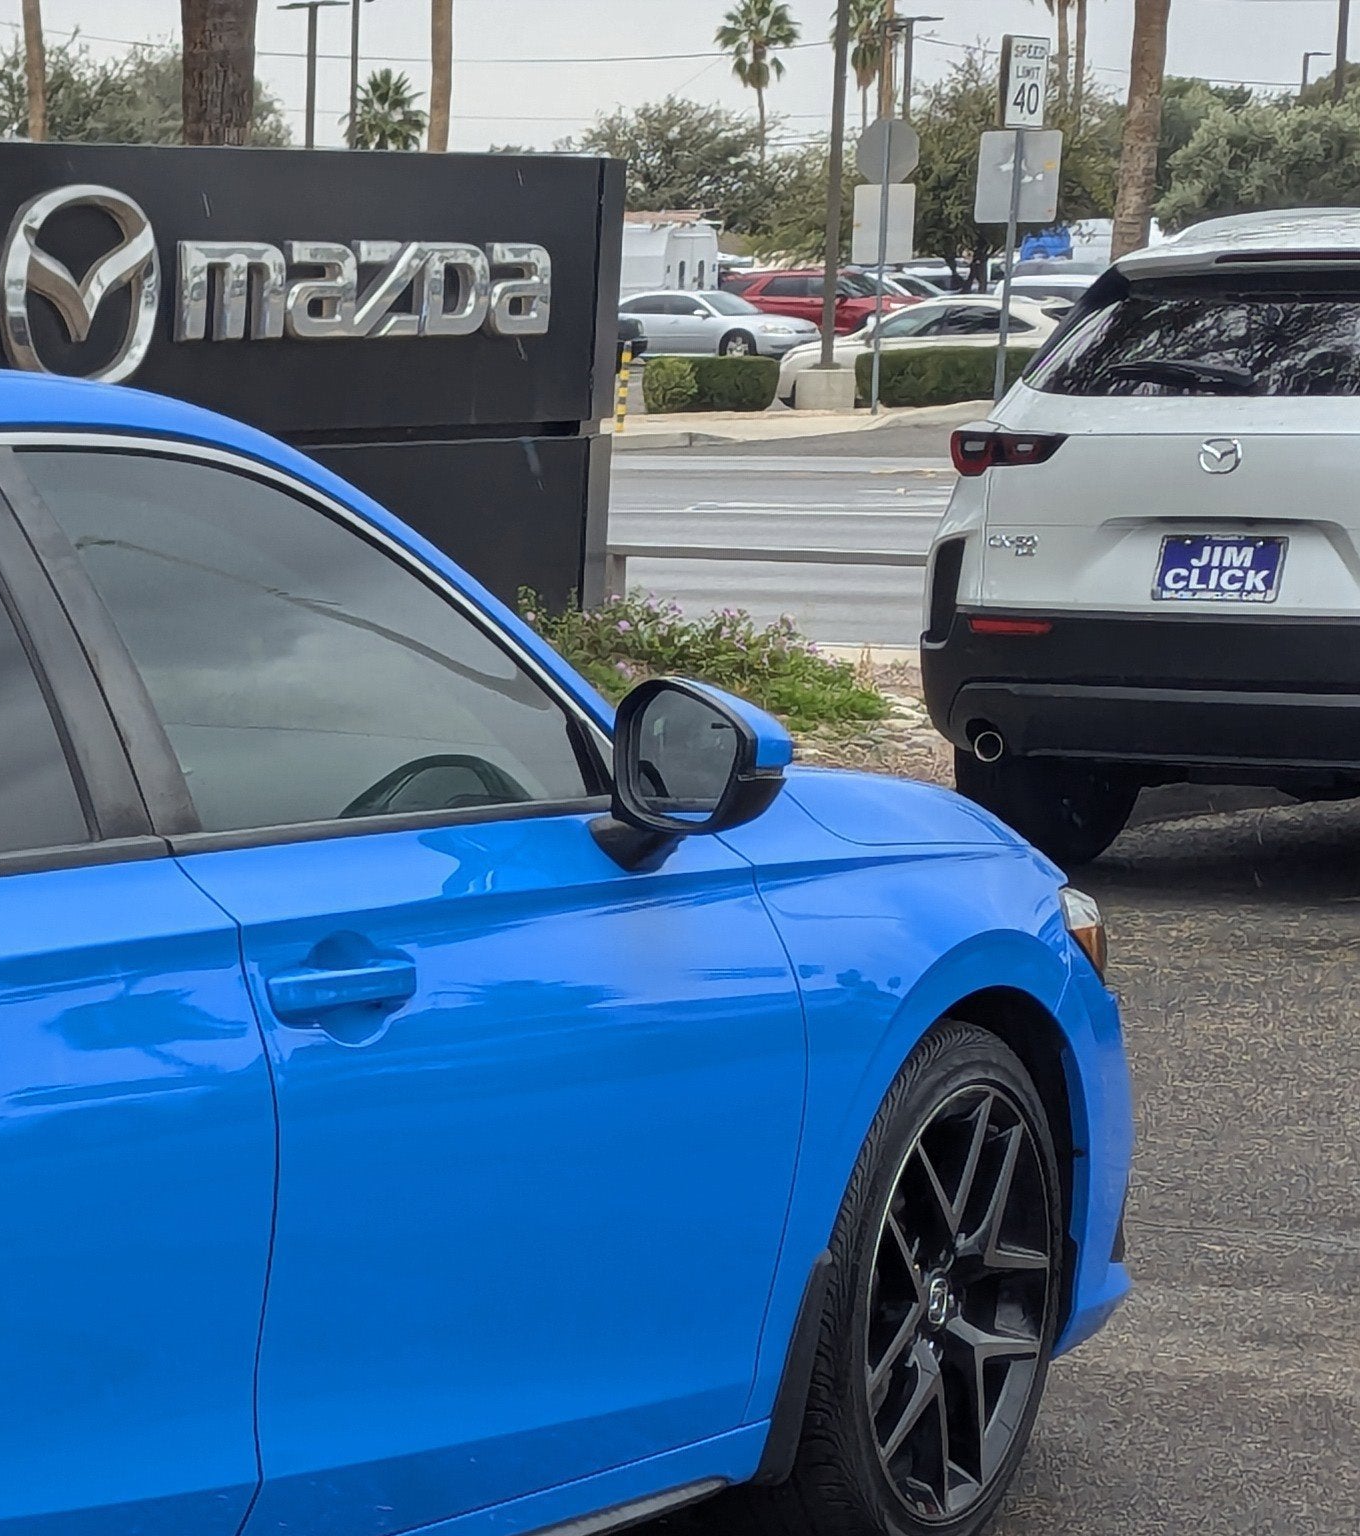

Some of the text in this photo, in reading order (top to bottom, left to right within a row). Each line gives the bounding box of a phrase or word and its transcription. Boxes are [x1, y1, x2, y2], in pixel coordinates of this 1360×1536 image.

[1014, 44, 1047, 59] SPEED
[1013, 82, 1039, 115] 40
[1190, 545, 1254, 567] JIM
[1164, 567, 1270, 592] CLICK
